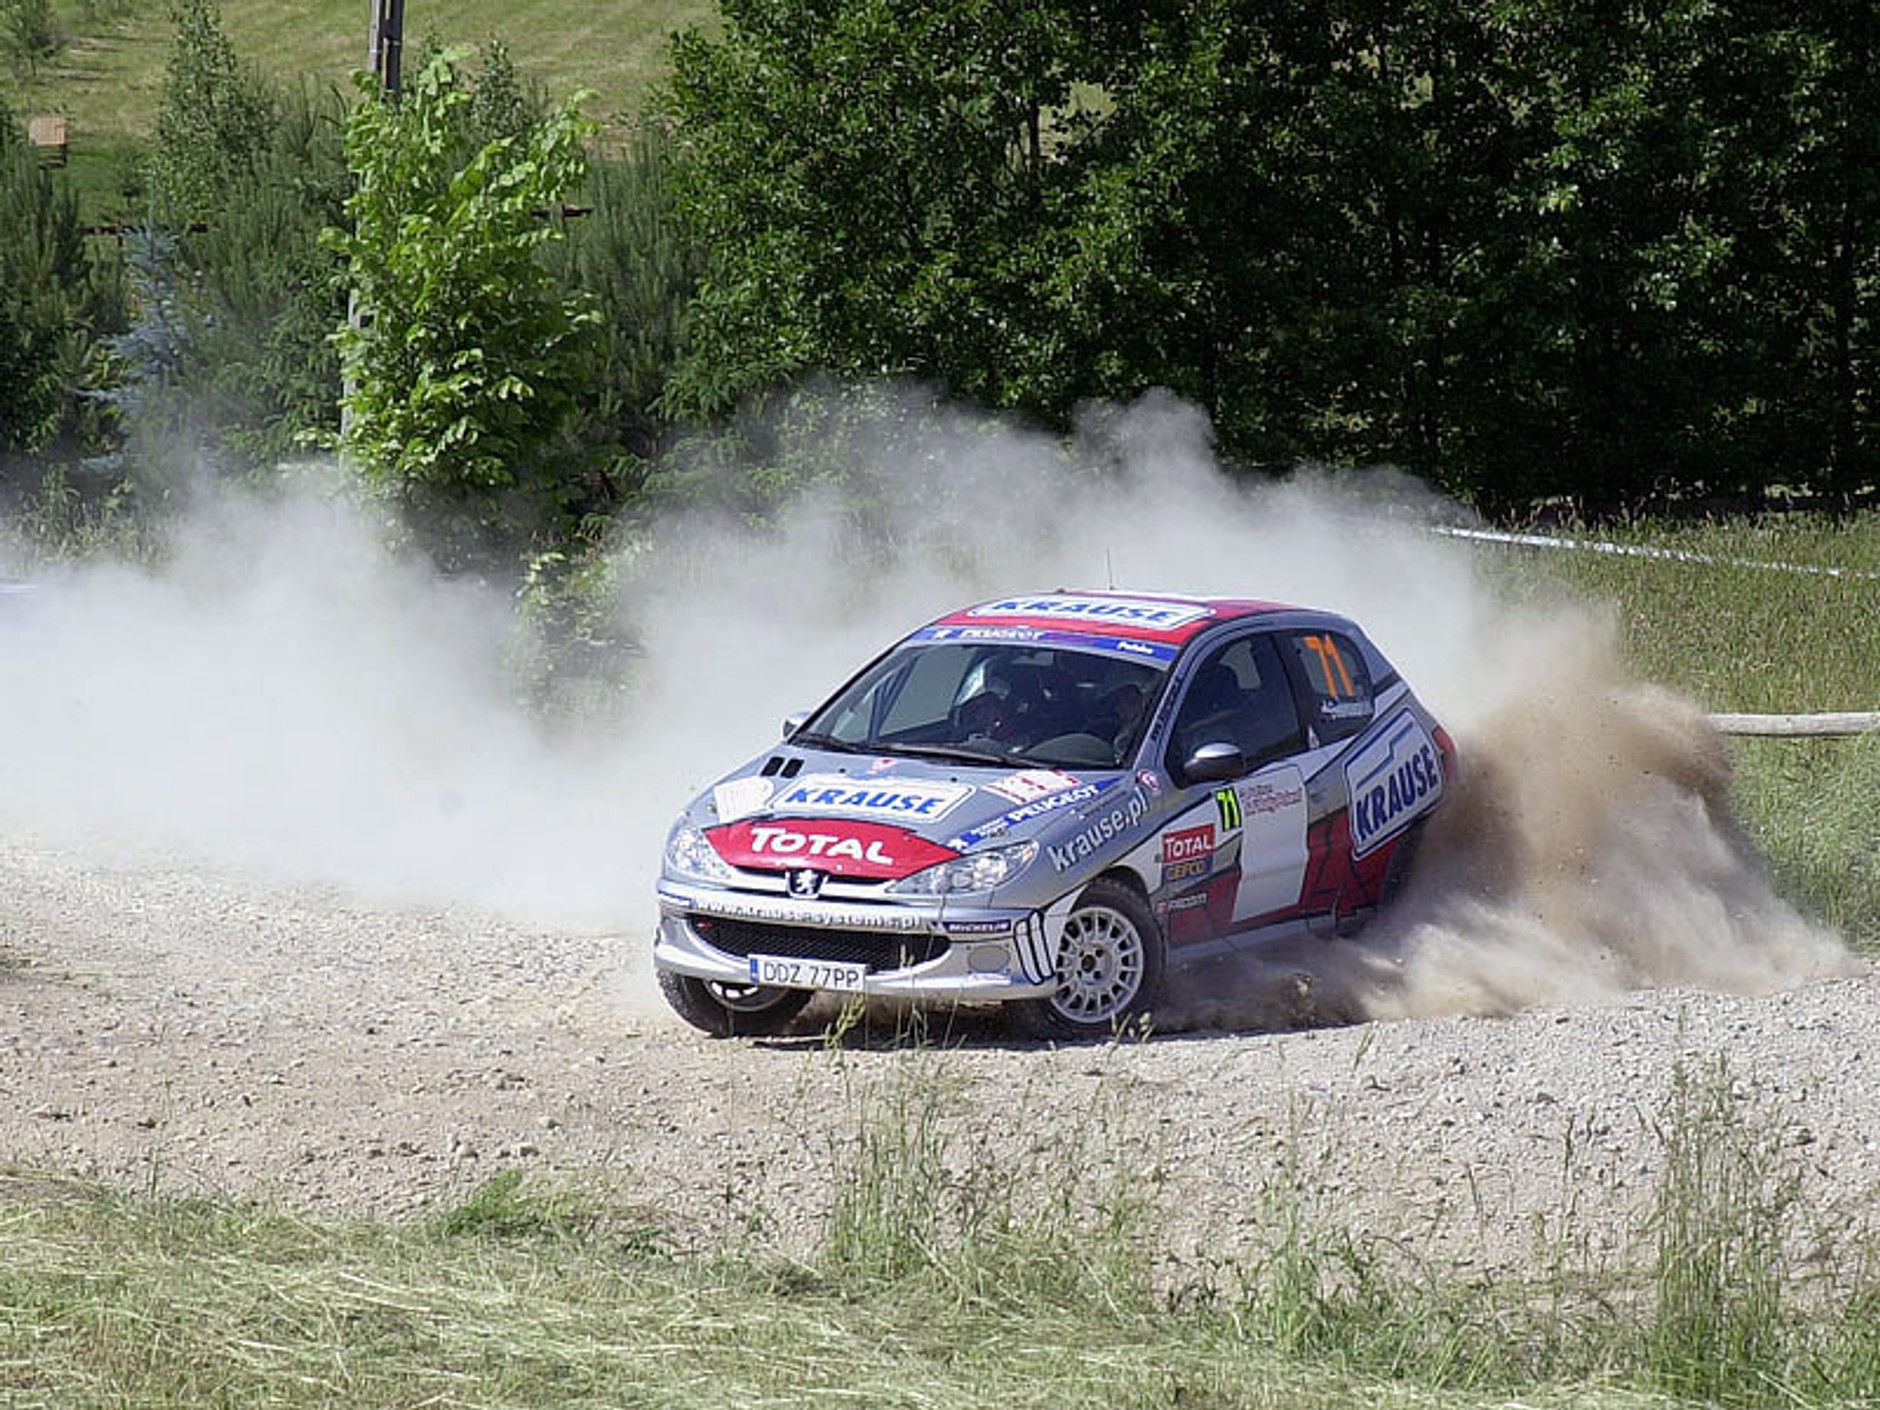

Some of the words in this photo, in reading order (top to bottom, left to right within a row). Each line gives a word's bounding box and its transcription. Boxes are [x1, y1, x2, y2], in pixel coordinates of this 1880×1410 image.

[992, 600, 1181, 622] KRAUSE
[1304, 634, 1355, 698] 71
[786, 787, 944, 816] KRAUSE
[1216, 789, 1240, 830] 71
[1356, 743, 1439, 842] KRAUSE
[751, 827, 893, 866] TOTAL
[1047, 785, 1150, 873] krause.pl
[1165, 833, 1212, 857] TOTAL
[763, 961, 801, 983] DDZ
[809, 965, 859, 988] 77PP
